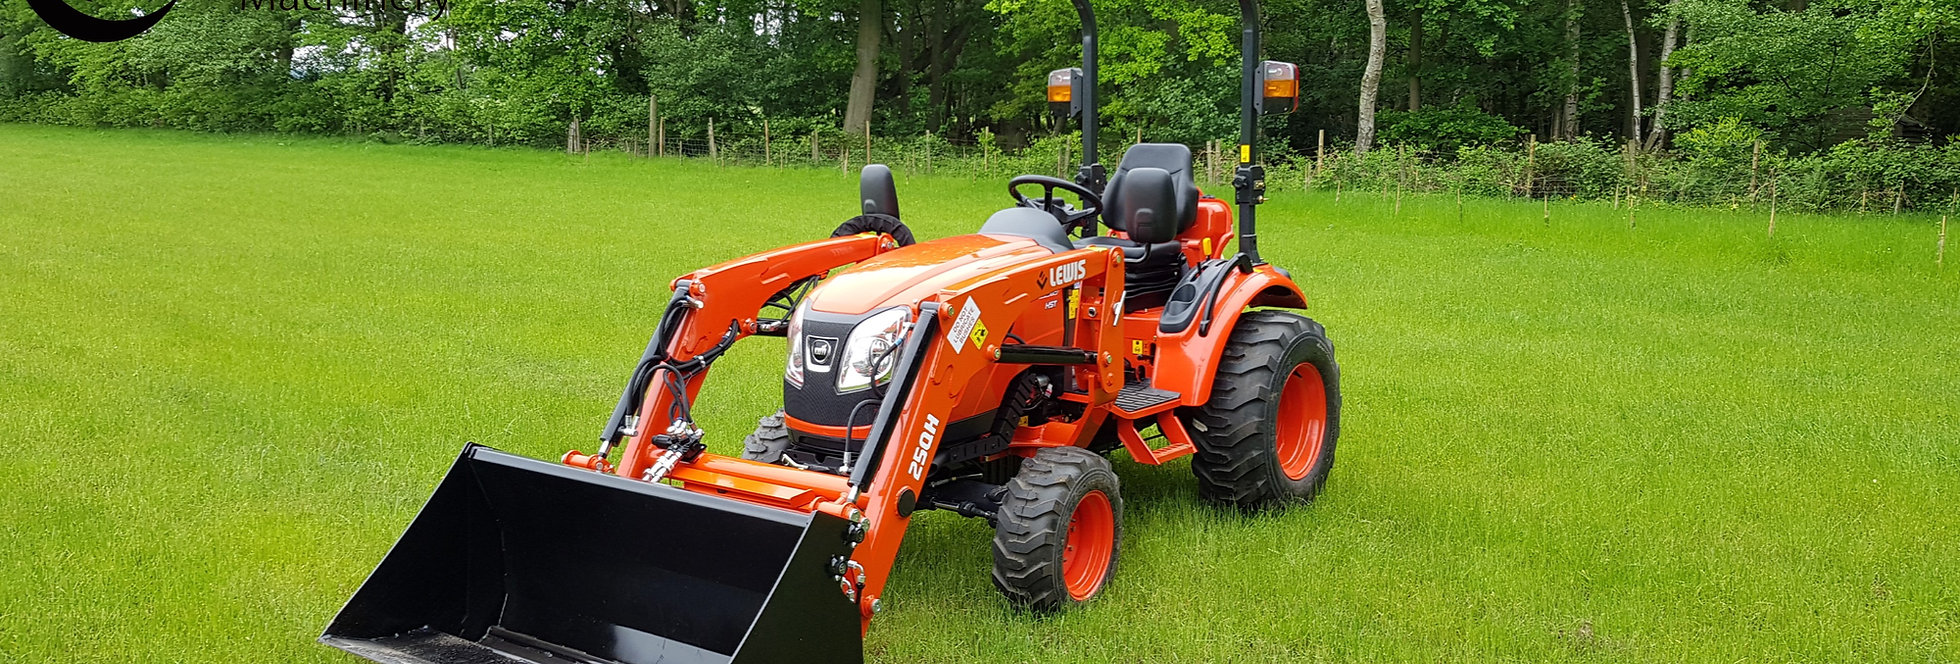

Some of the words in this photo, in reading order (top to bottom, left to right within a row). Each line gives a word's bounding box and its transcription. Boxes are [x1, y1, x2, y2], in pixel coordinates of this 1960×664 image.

[1050, 259, 1086, 287] LEWIS
[1045, 300, 1058, 309] HST
[953, 321, 960, 333] DO
[959, 306, 968, 322] NOT
[953, 306, 975, 343] LUBRICATE
